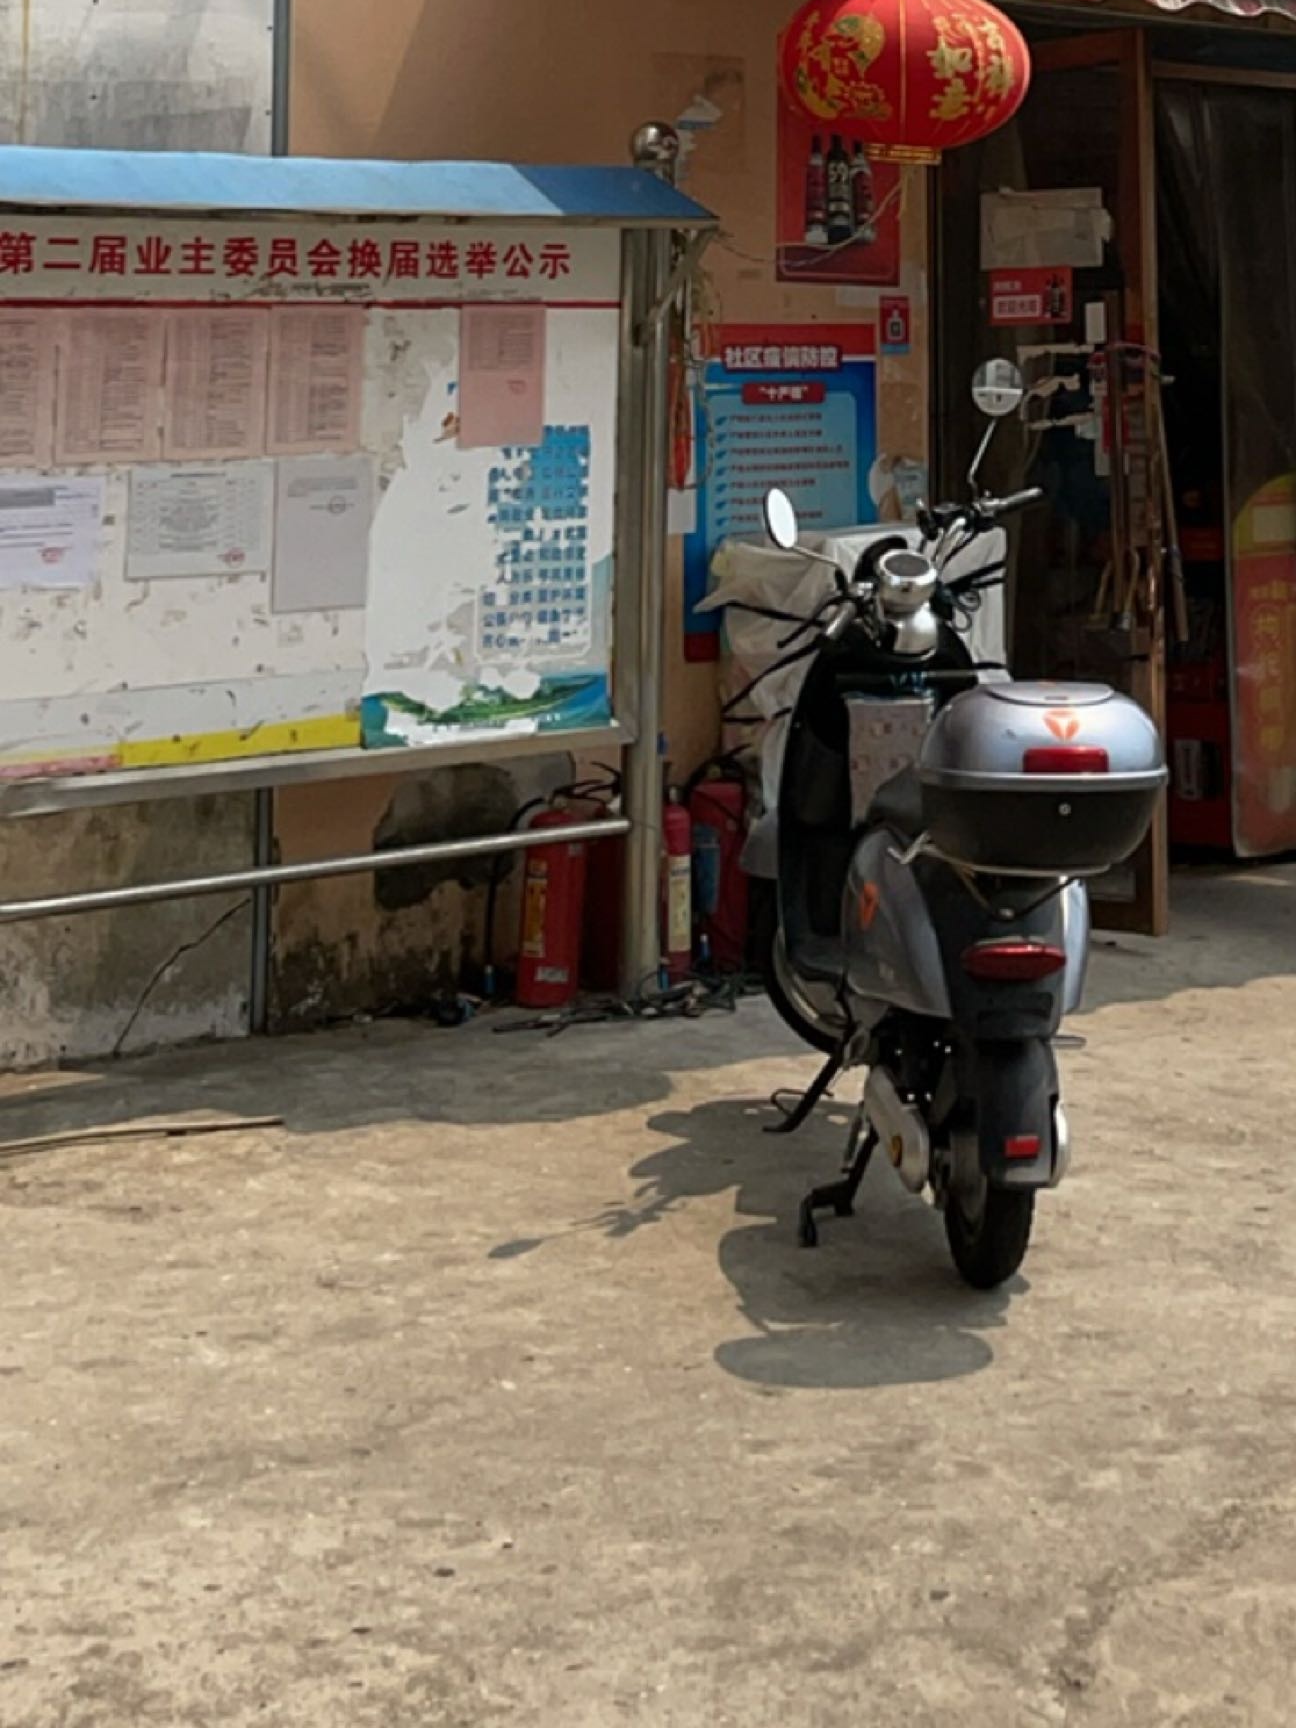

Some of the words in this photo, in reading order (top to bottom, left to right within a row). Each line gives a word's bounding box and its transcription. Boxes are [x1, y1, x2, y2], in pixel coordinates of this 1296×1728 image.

[0, 231, 572, 280] 第二届业主委员会换届选举公示
